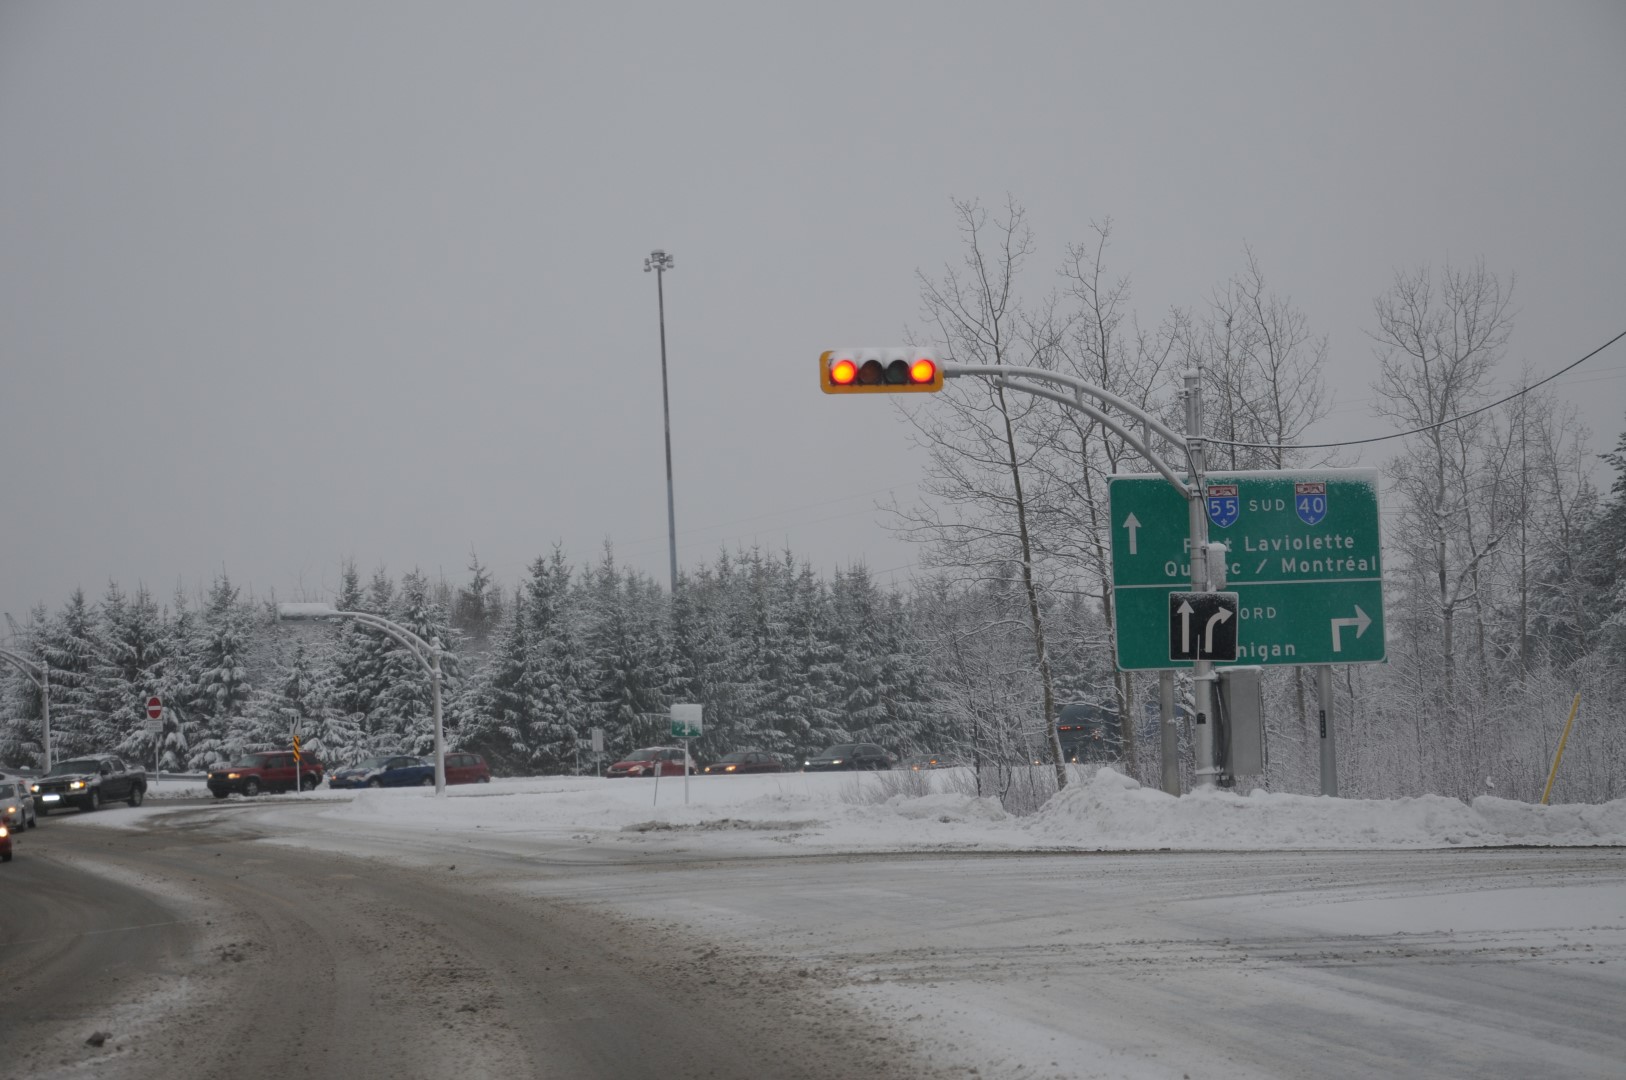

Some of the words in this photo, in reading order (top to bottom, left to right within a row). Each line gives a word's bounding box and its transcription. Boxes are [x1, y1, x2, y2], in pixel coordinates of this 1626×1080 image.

[1211, 500, 1236, 516] 55
[1249, 499, 1285, 512] SUD
[1299, 497, 1324, 514] 40
[1183, 537, 1233, 554] Pt
[1244, 534, 1355, 552] Laviolette
[1164, 561, 1241, 577] Quc
[1255, 558, 1268, 574] /
[1281, 555, 1377, 574] Montréal
[1239, 606, 1277, 620] ORD
[1237, 642, 1296, 662] nigan
